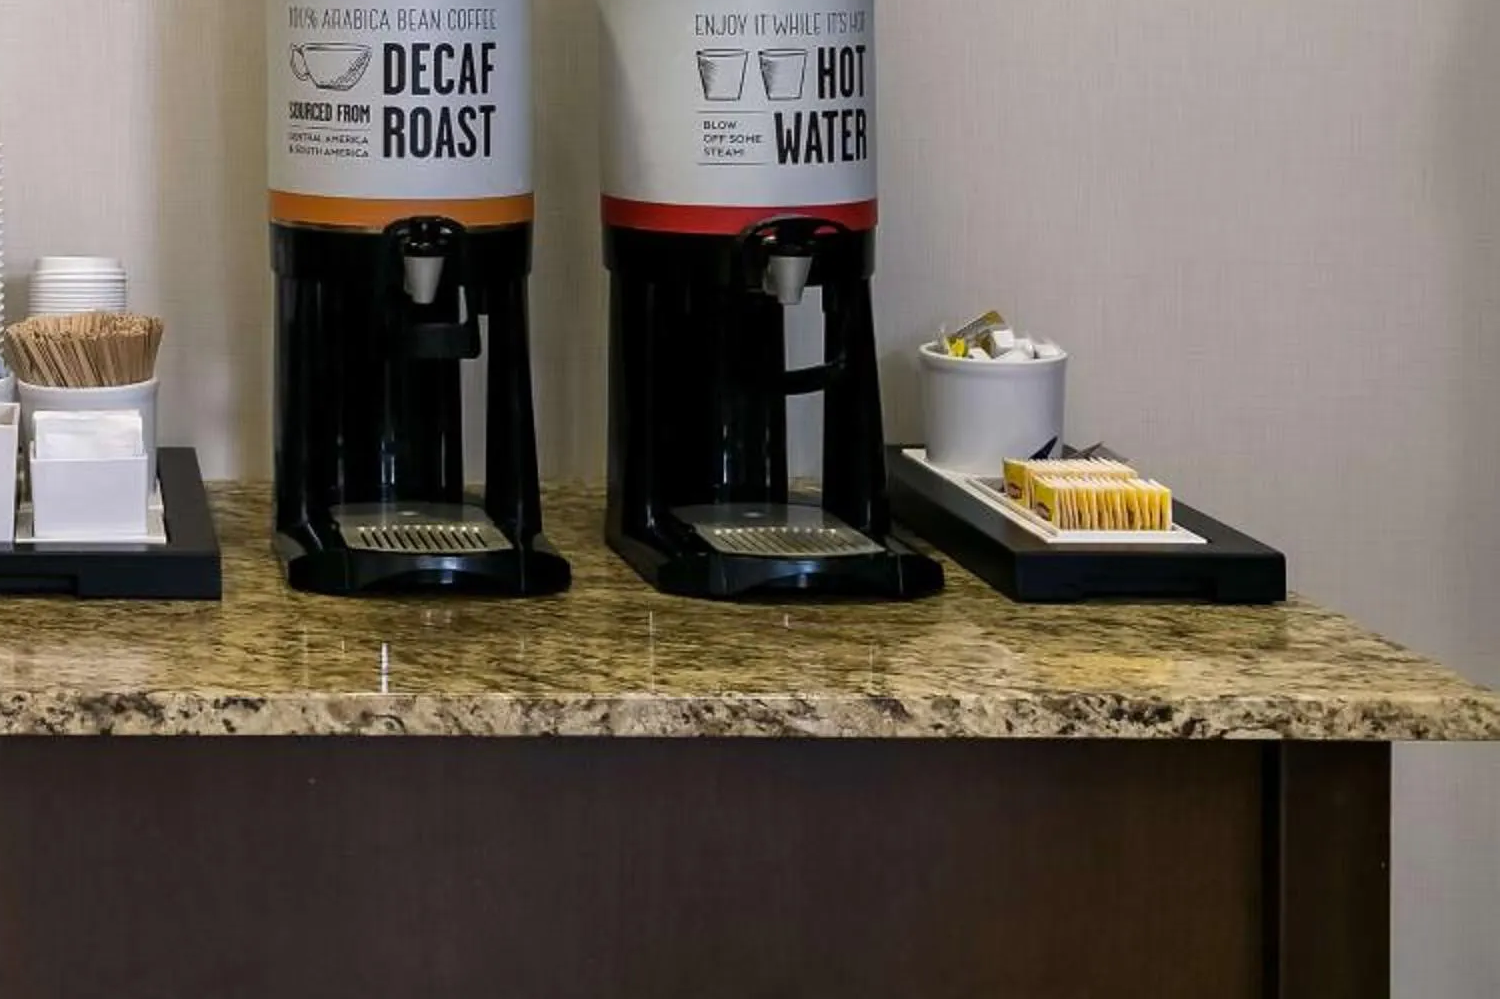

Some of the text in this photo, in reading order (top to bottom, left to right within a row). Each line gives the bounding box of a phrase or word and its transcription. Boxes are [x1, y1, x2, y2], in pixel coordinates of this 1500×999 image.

[322, 8, 391, 30] ARABICA
[397, 9, 442, 31] BEAN
[448, 8, 497, 31] COFFEE
[695, 13, 748, 36] ENJOY
[755, 13, 767, 36] IT
[773, 12, 821, 36] WHILE
[382, 42, 497, 96] DECAF
[816, 46, 866, 100] HOT
[288, 101, 371, 123] SOURCED FROM
[382, 104, 497, 159] ROAST
[703, 120, 737, 129] BLOW
[773, 108, 868, 165] WATER
[703, 134, 764, 144] OFF SOME
